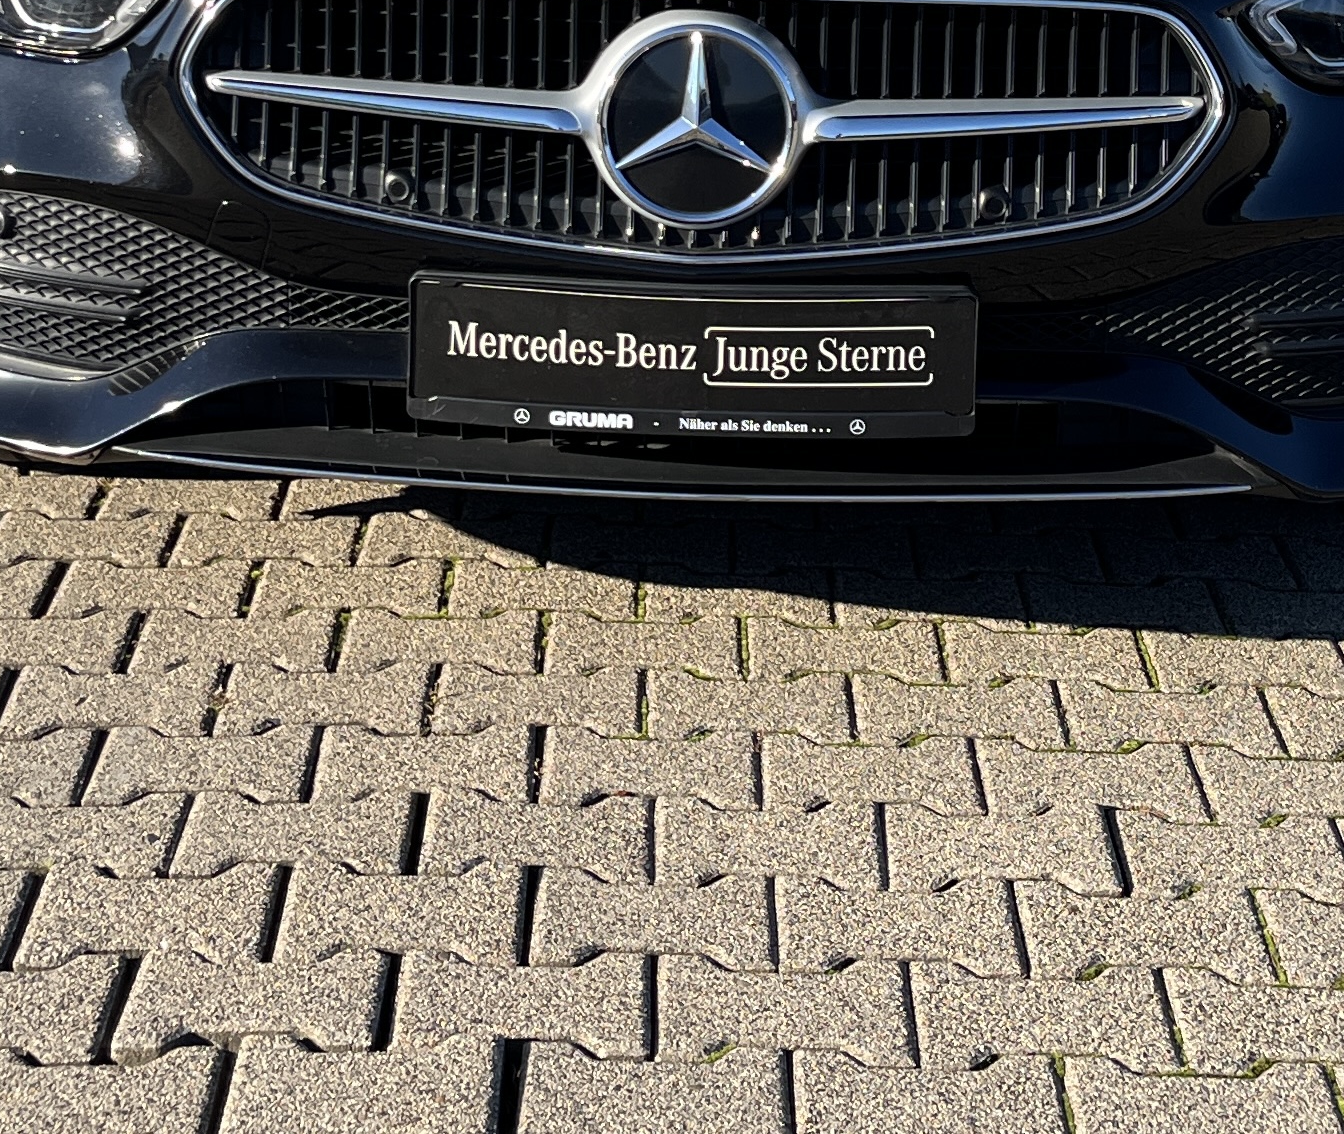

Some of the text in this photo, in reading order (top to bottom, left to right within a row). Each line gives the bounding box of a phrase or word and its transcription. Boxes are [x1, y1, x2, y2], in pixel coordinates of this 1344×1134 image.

[447, 320, 926, 380] Mercedes-Benz Junge Sterne
[549, 410, 633, 429] GRUMA
[679, 417, 718, 430] Näher
[720, 419, 738, 431] als
[741, 419, 760, 431] Sie
[763, 420, 808, 433] denken
